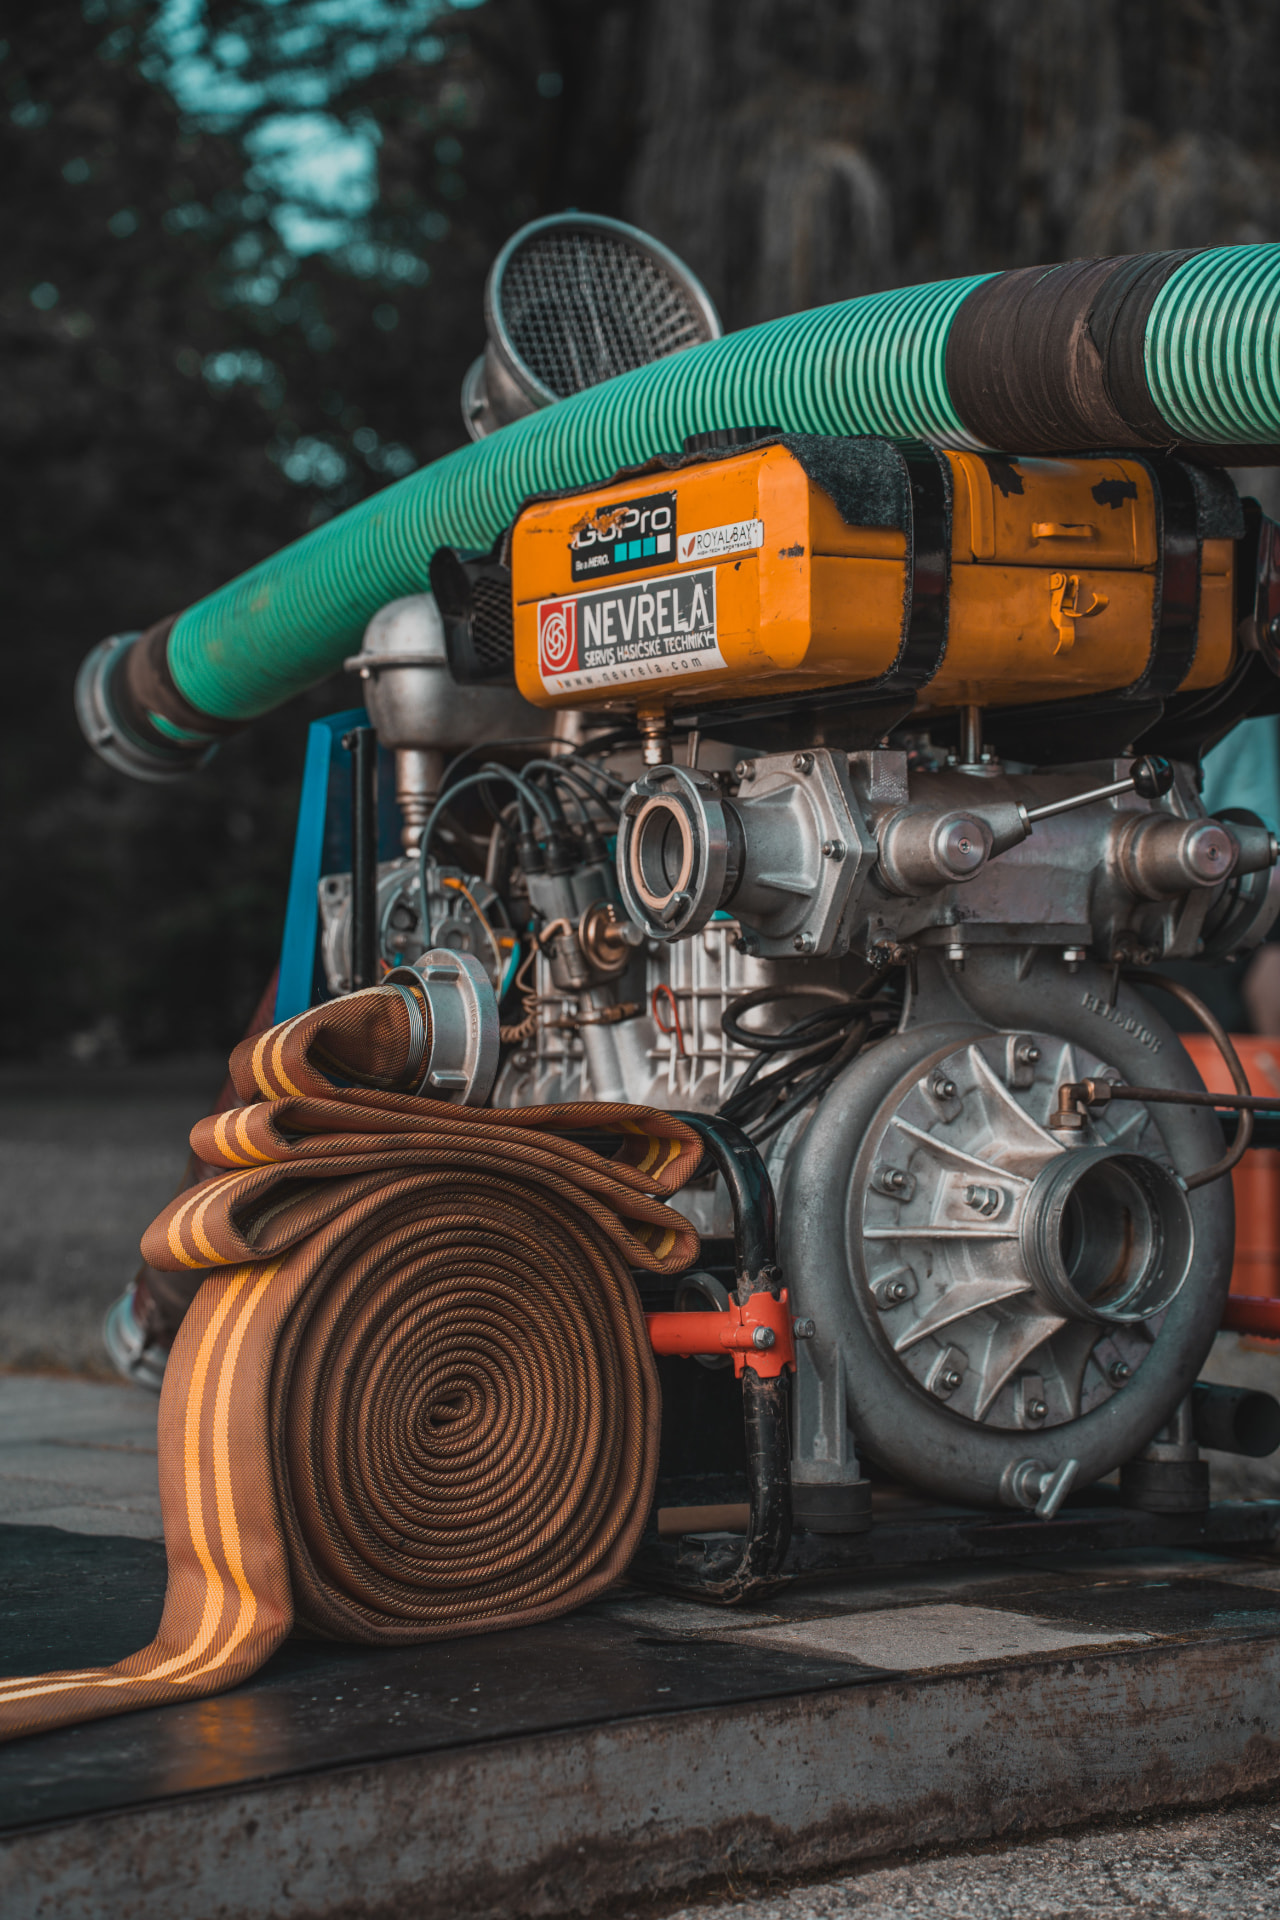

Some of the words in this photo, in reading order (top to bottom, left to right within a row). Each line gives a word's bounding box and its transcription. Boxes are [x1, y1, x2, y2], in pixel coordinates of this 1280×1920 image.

[576, 507, 671, 548] GoPro
[584, 647, 616, 667] SERVIS
[664, 632, 711, 654] TECHNIKY
[563, 657, 702, 688] www.nevrela.com
